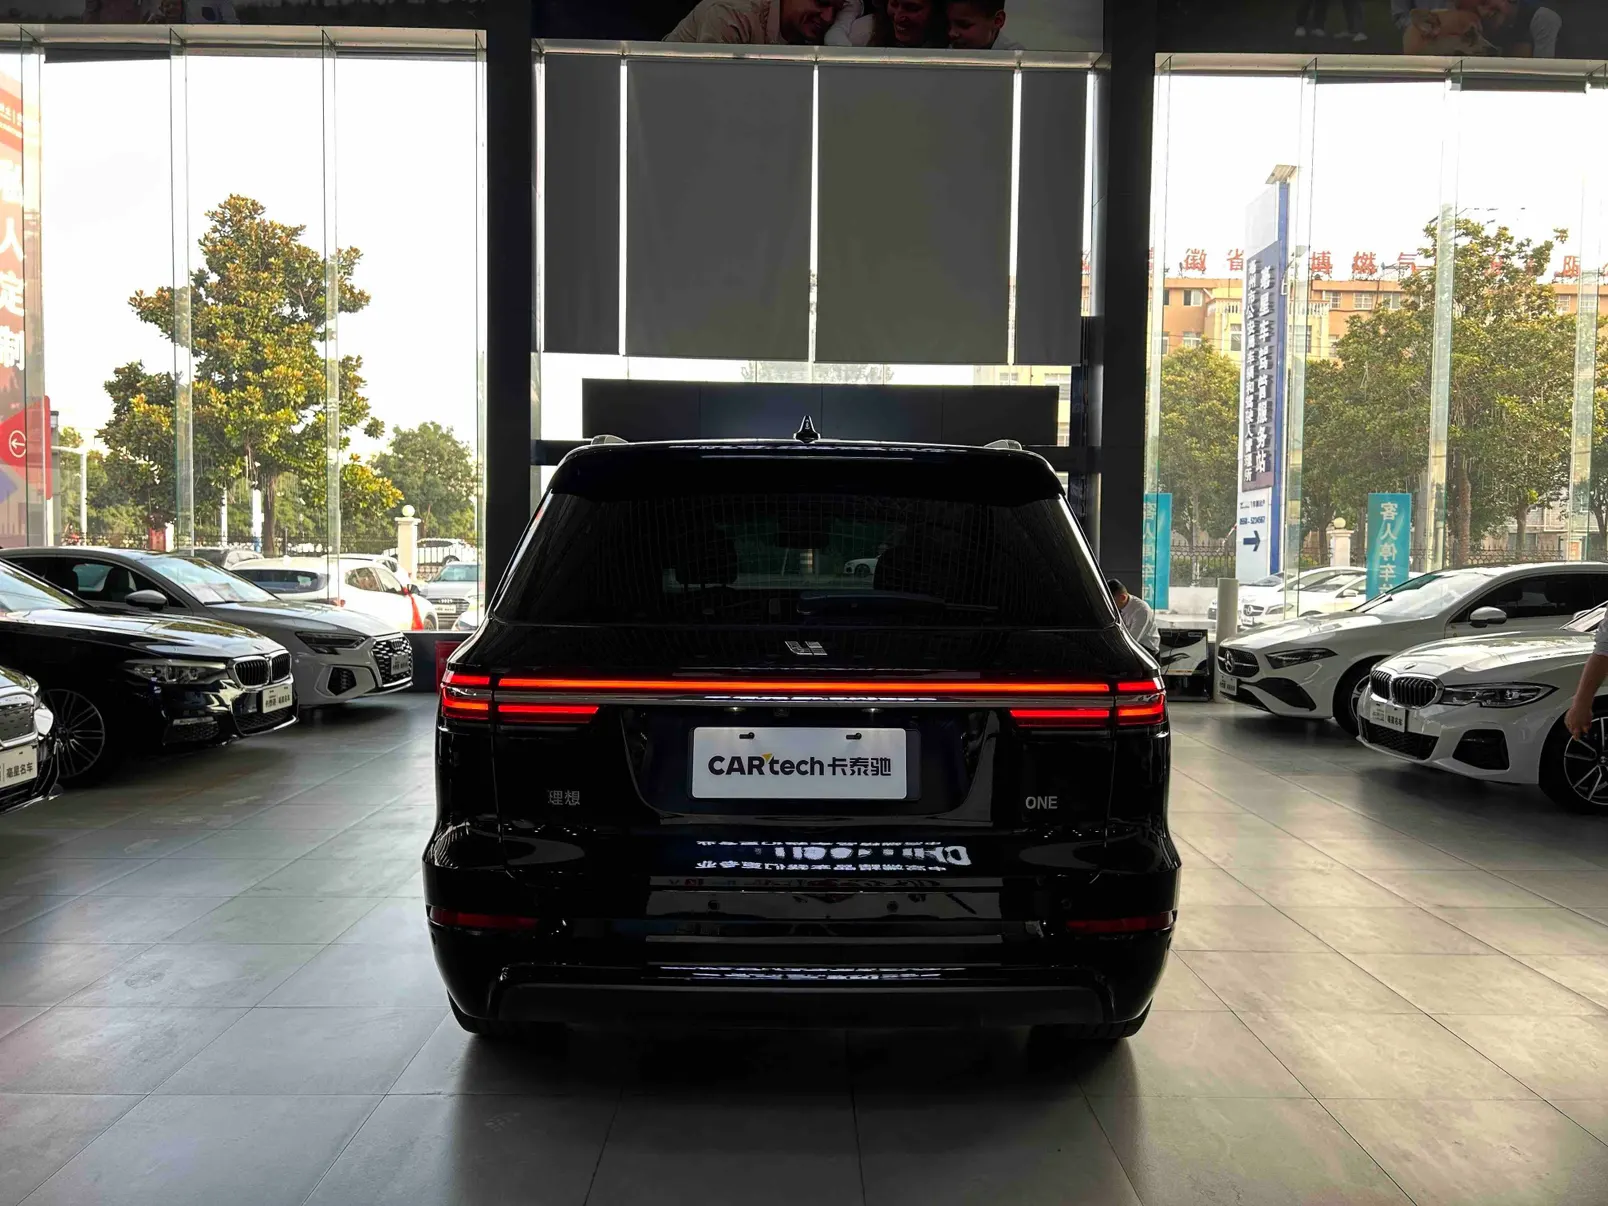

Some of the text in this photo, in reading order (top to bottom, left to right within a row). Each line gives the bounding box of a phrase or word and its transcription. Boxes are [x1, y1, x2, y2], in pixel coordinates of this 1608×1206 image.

[708, 753, 892, 776] CARtech 卡泰驰
[549, 790, 581, 806] 理想
[1025, 796, 1058, 810] ONE
